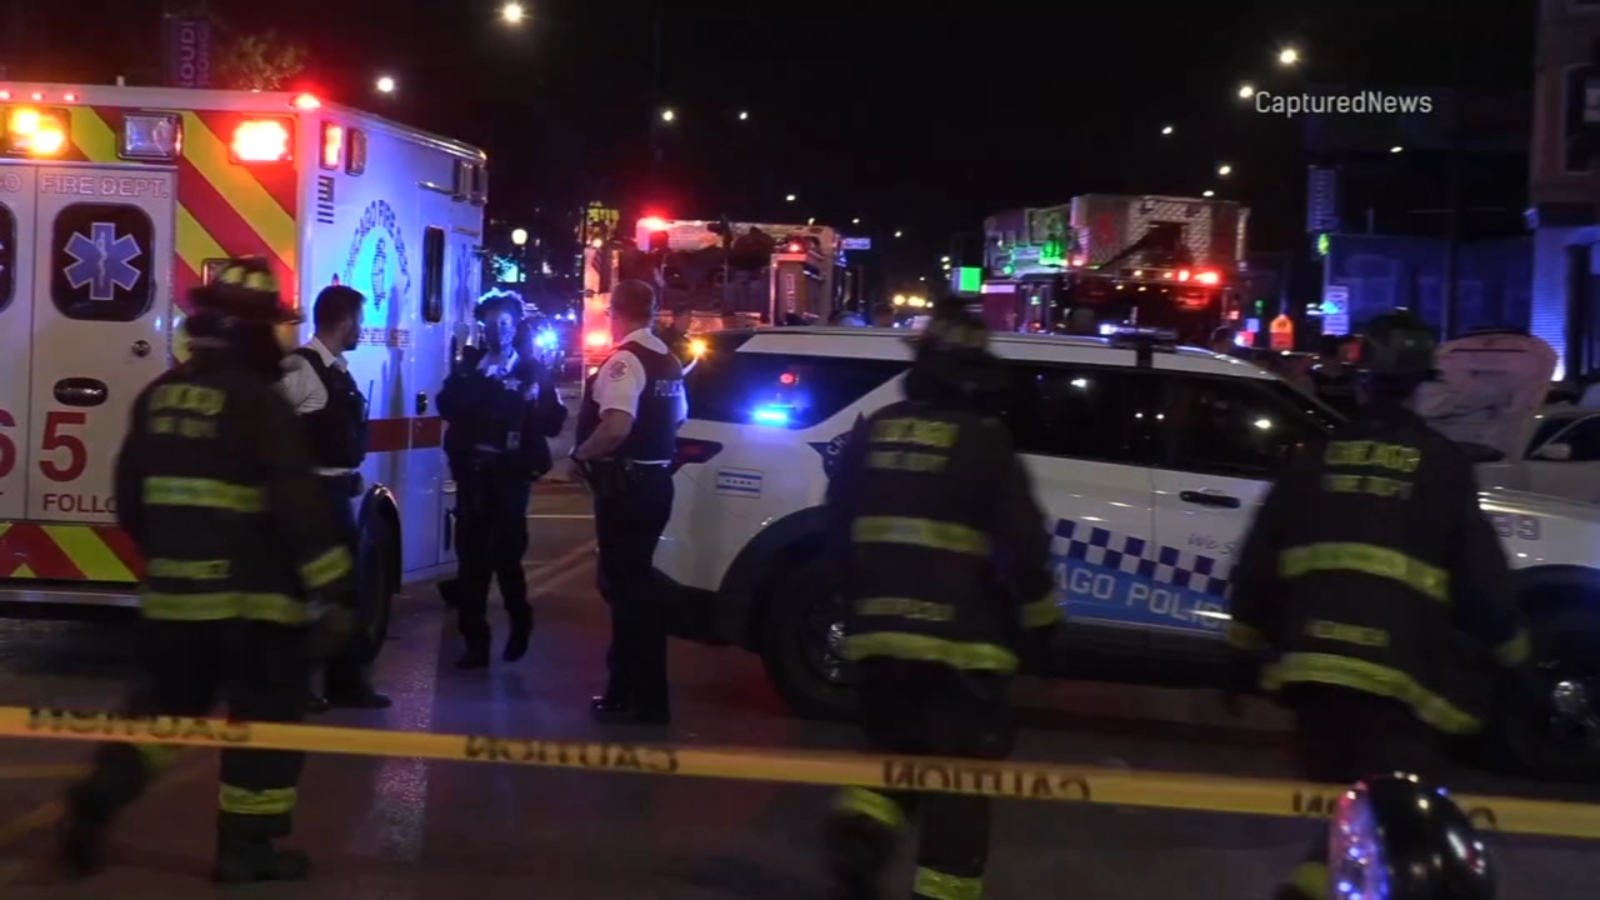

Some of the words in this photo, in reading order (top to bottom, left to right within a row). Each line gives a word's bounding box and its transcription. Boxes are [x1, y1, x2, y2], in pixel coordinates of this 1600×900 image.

[40, 173, 95, 195] FIRE
[101, 177, 170, 199] DEPT.
[43, 493, 117, 514] FOLLO
[1054, 562, 1116, 601] AGO
[1125, 581, 1224, 629] POLIC
